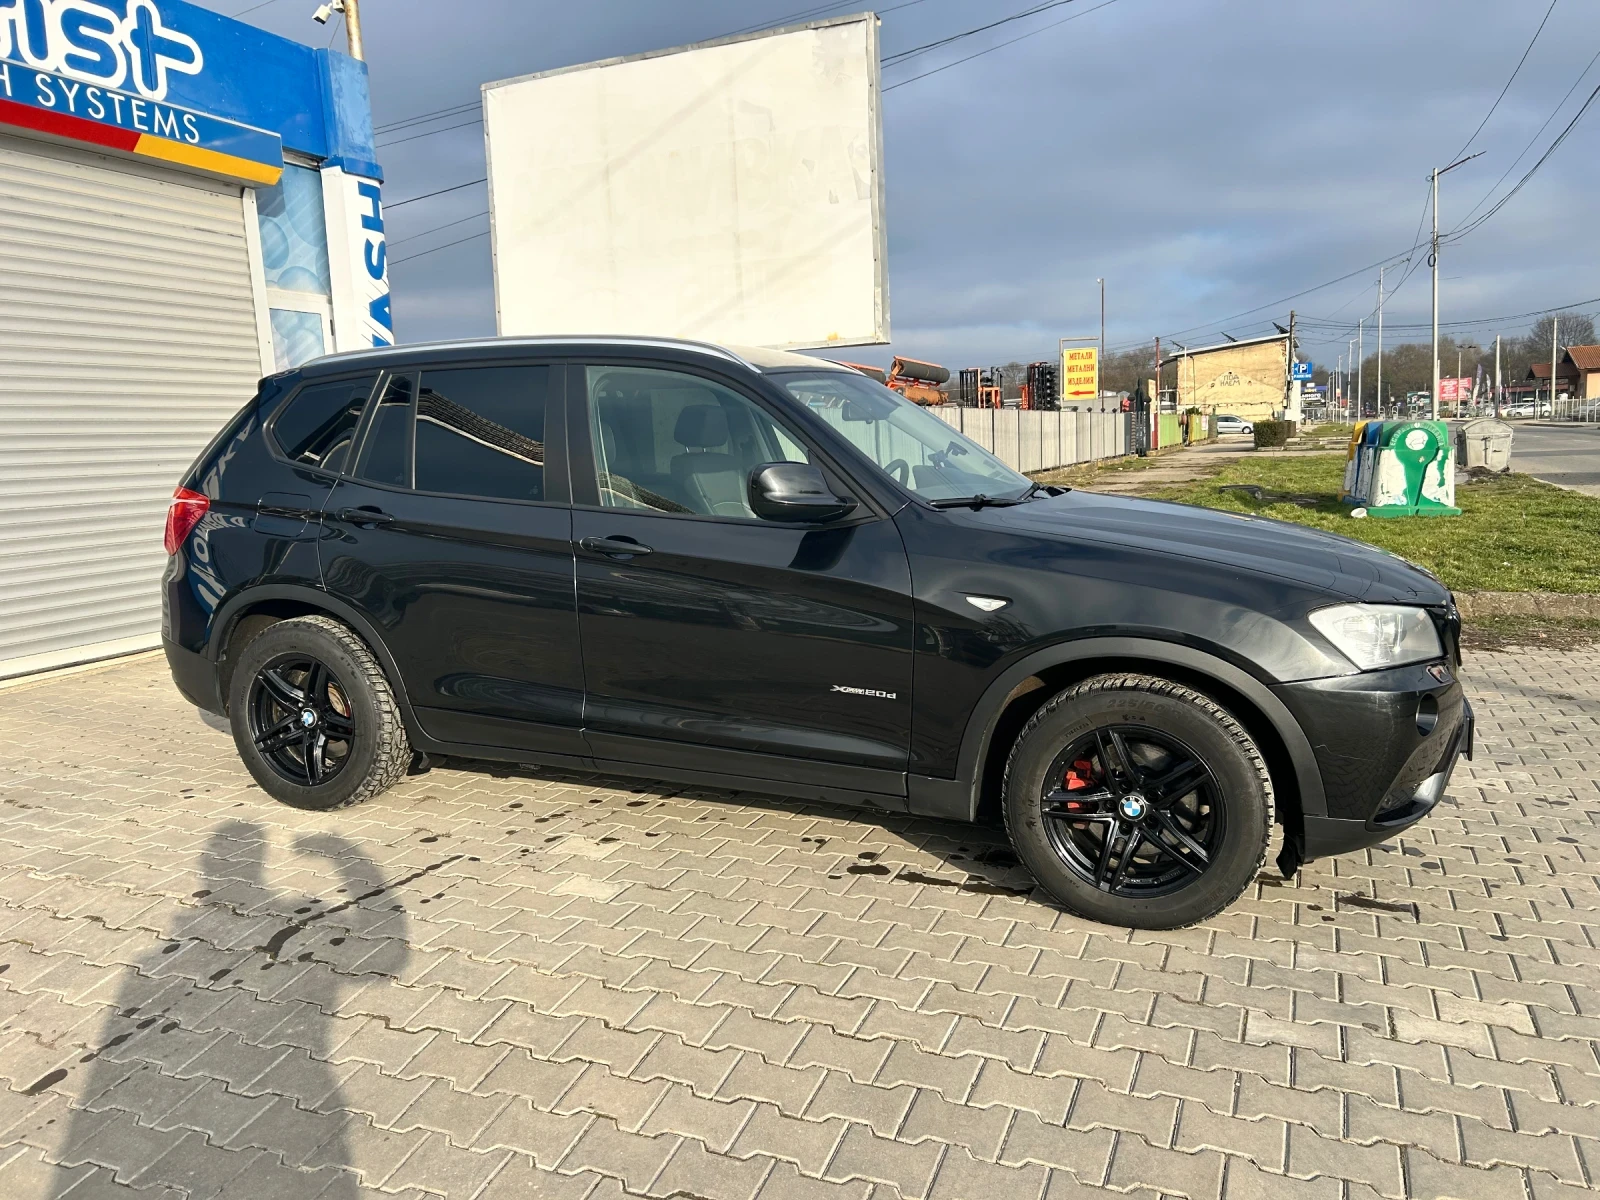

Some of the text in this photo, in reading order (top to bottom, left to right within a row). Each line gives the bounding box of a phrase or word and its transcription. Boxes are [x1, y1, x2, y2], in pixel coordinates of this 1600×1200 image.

[35, 73, 200, 144] SYSTEMS
[357, 180, 394, 347] ASH
[1069, 351, 1093, 360] МЕТАЛИ
[1067, 363, 1095, 373] МЕТАЛНИ
[1067, 376, 1094, 386] ИЗДЕЛИЯ
